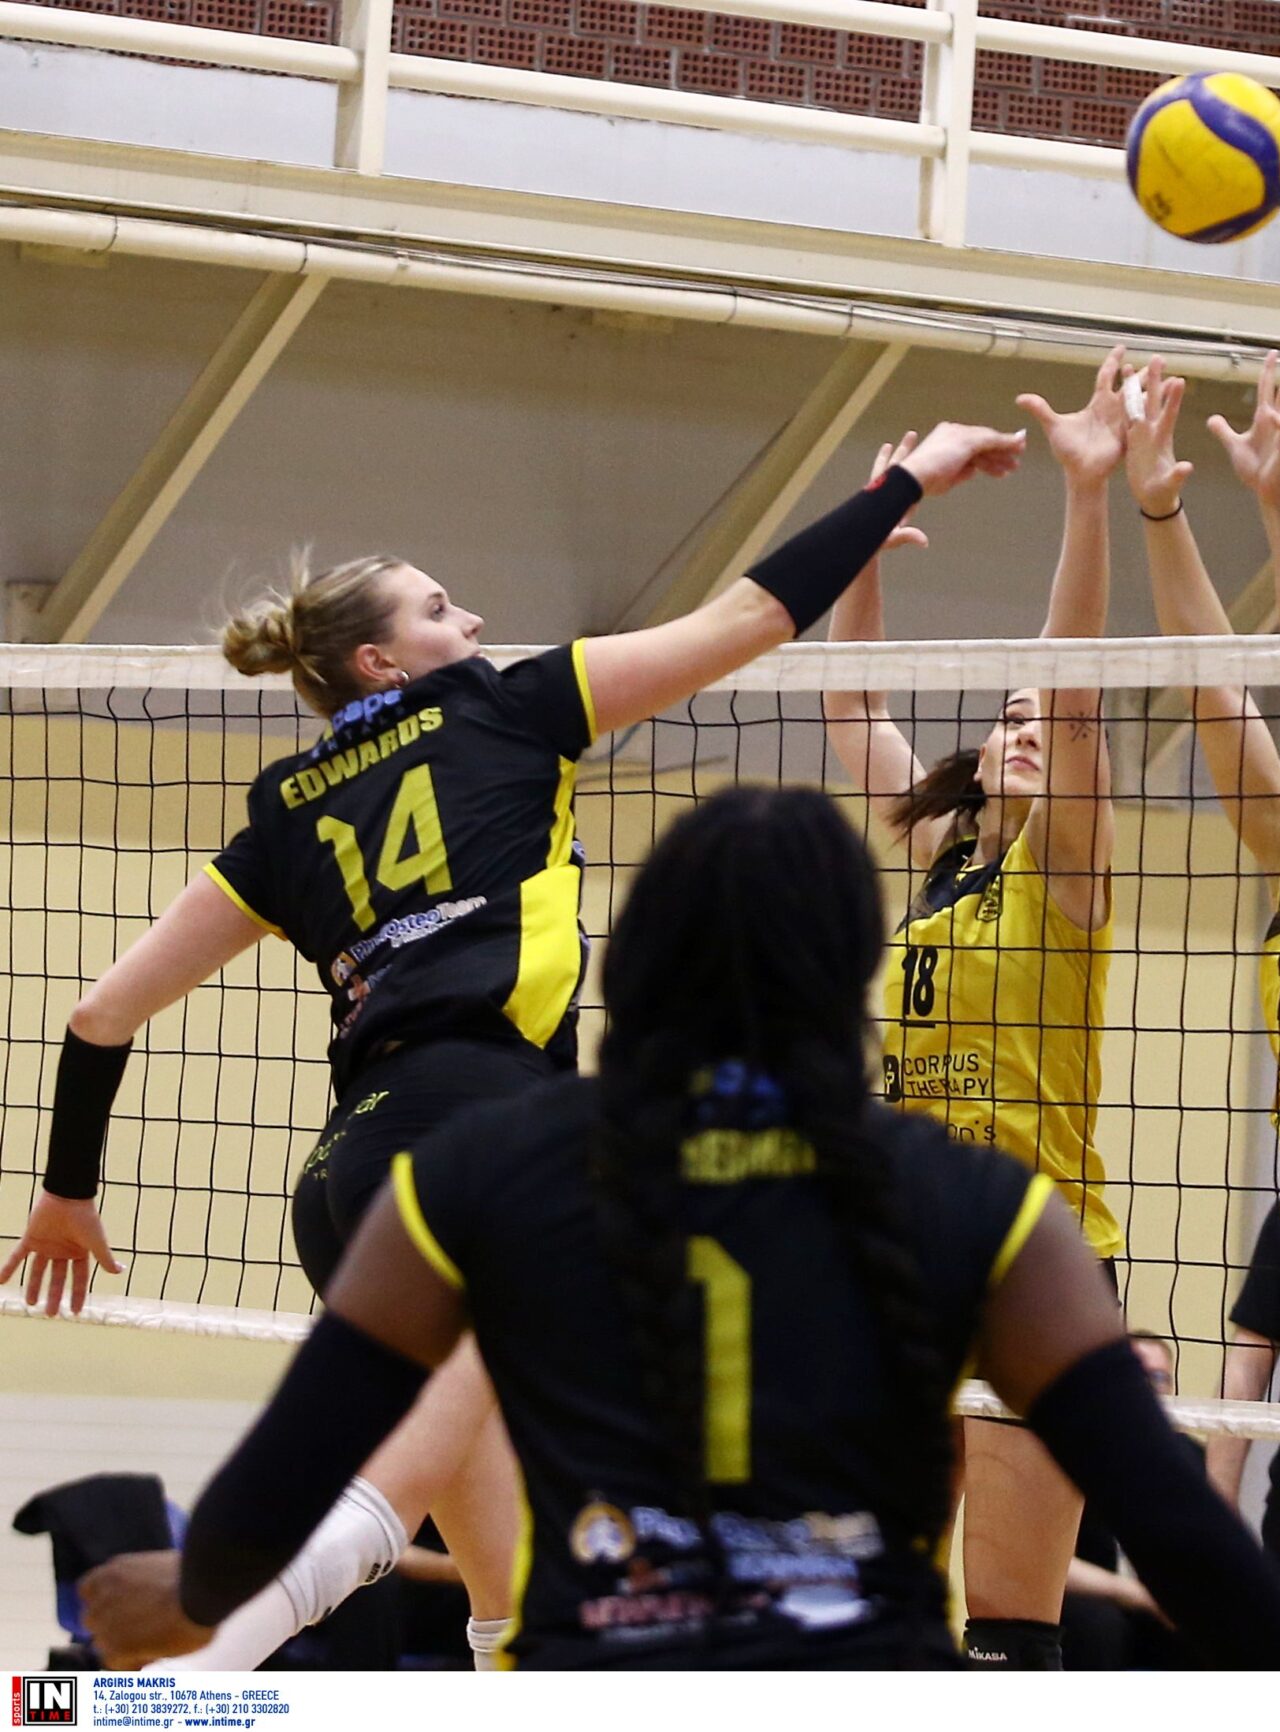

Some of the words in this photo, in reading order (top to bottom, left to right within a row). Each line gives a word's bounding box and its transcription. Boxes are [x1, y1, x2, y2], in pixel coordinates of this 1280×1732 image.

[280, 706, 444, 810] EDWARDS
[317, 763, 453, 932] 14
[902, 946, 938, 1017] 18
[903, 1054, 980, 1076] CORPUS
[686, 1235, 752, 1484] 1
